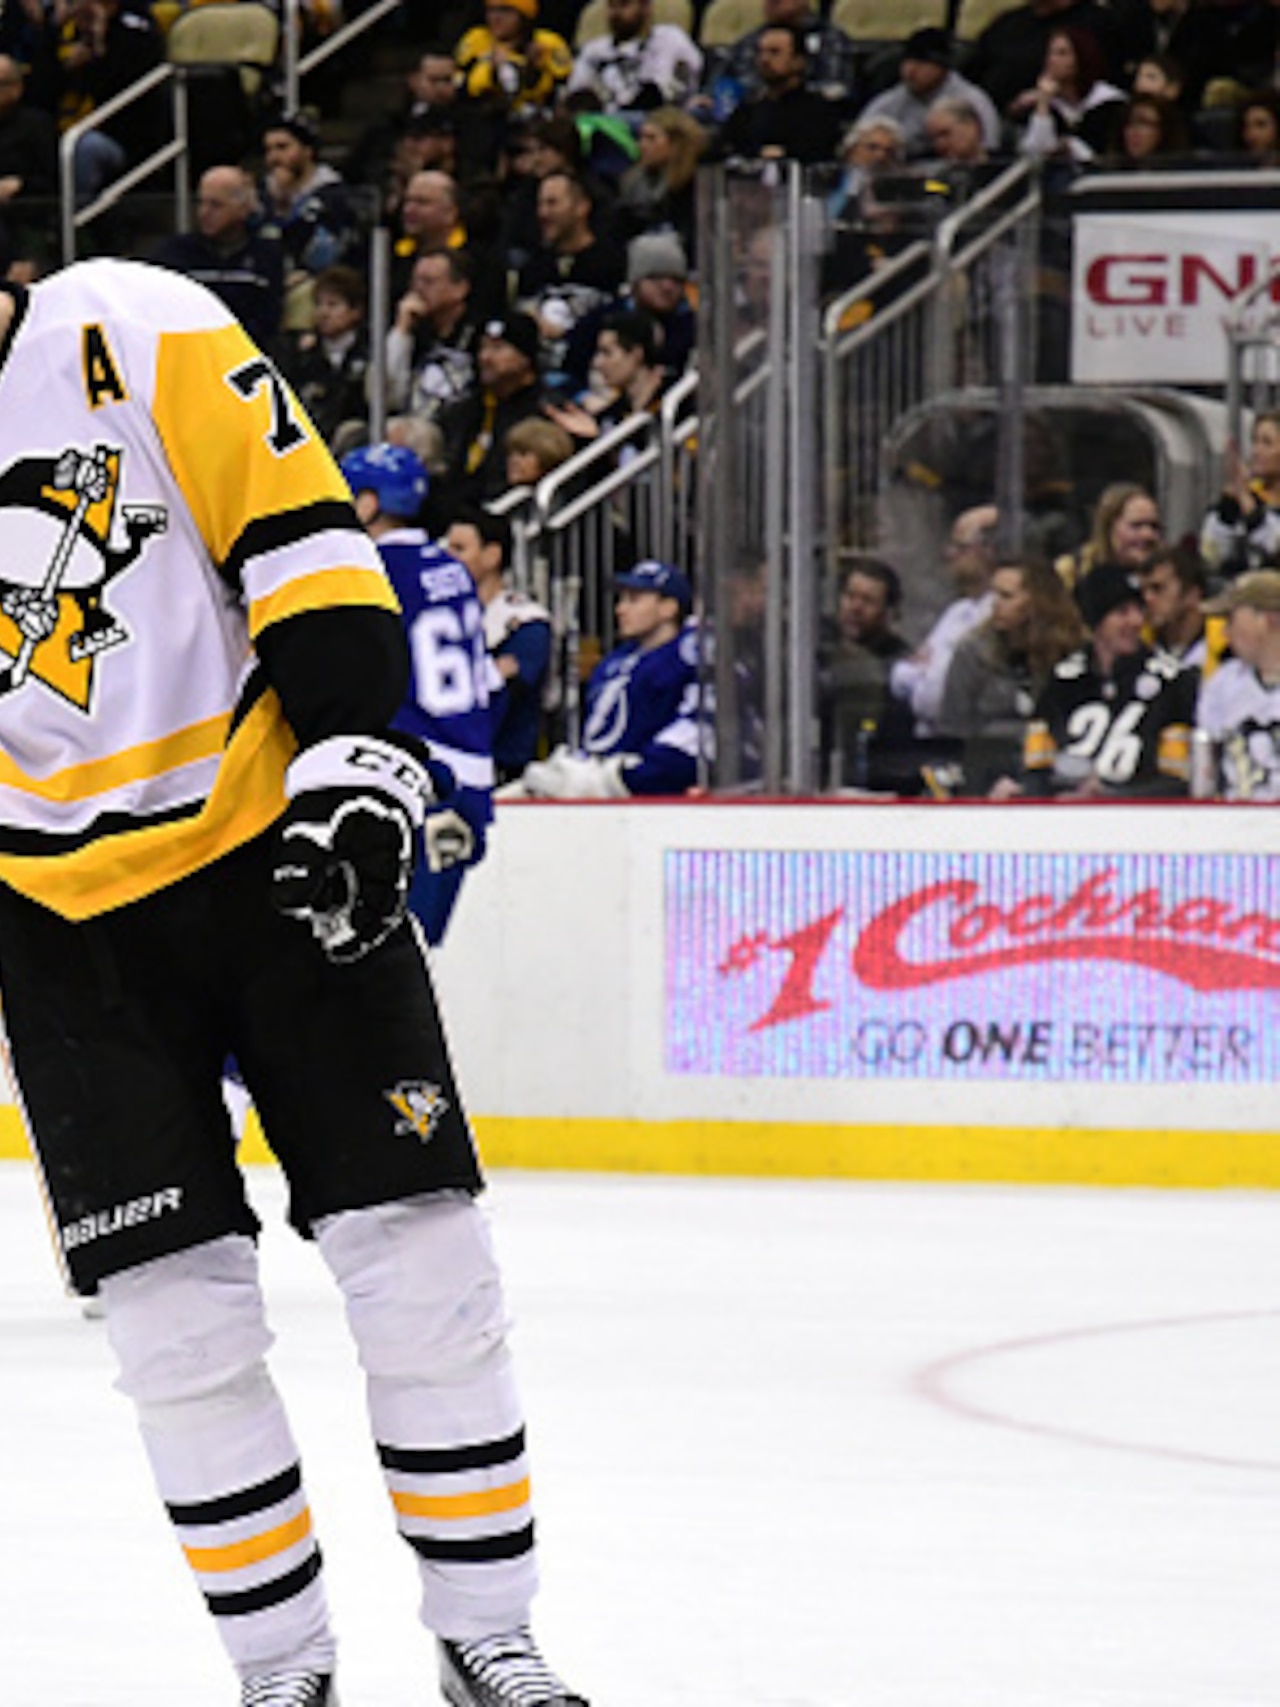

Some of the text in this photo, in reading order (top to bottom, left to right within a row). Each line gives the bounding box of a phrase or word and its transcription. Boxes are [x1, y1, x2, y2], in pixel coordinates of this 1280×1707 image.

[1086, 253, 1280, 306] GN
[1087, 313, 1185, 340] LIVE
[82, 322, 130, 412] A
[1066, 701, 1146, 783] 26
[720, 867, 1280, 1031] #1 Cochran
[856, 1019, 1256, 1070] GO ONE BETTER
[63, 1187, 182, 1250] BAUER
